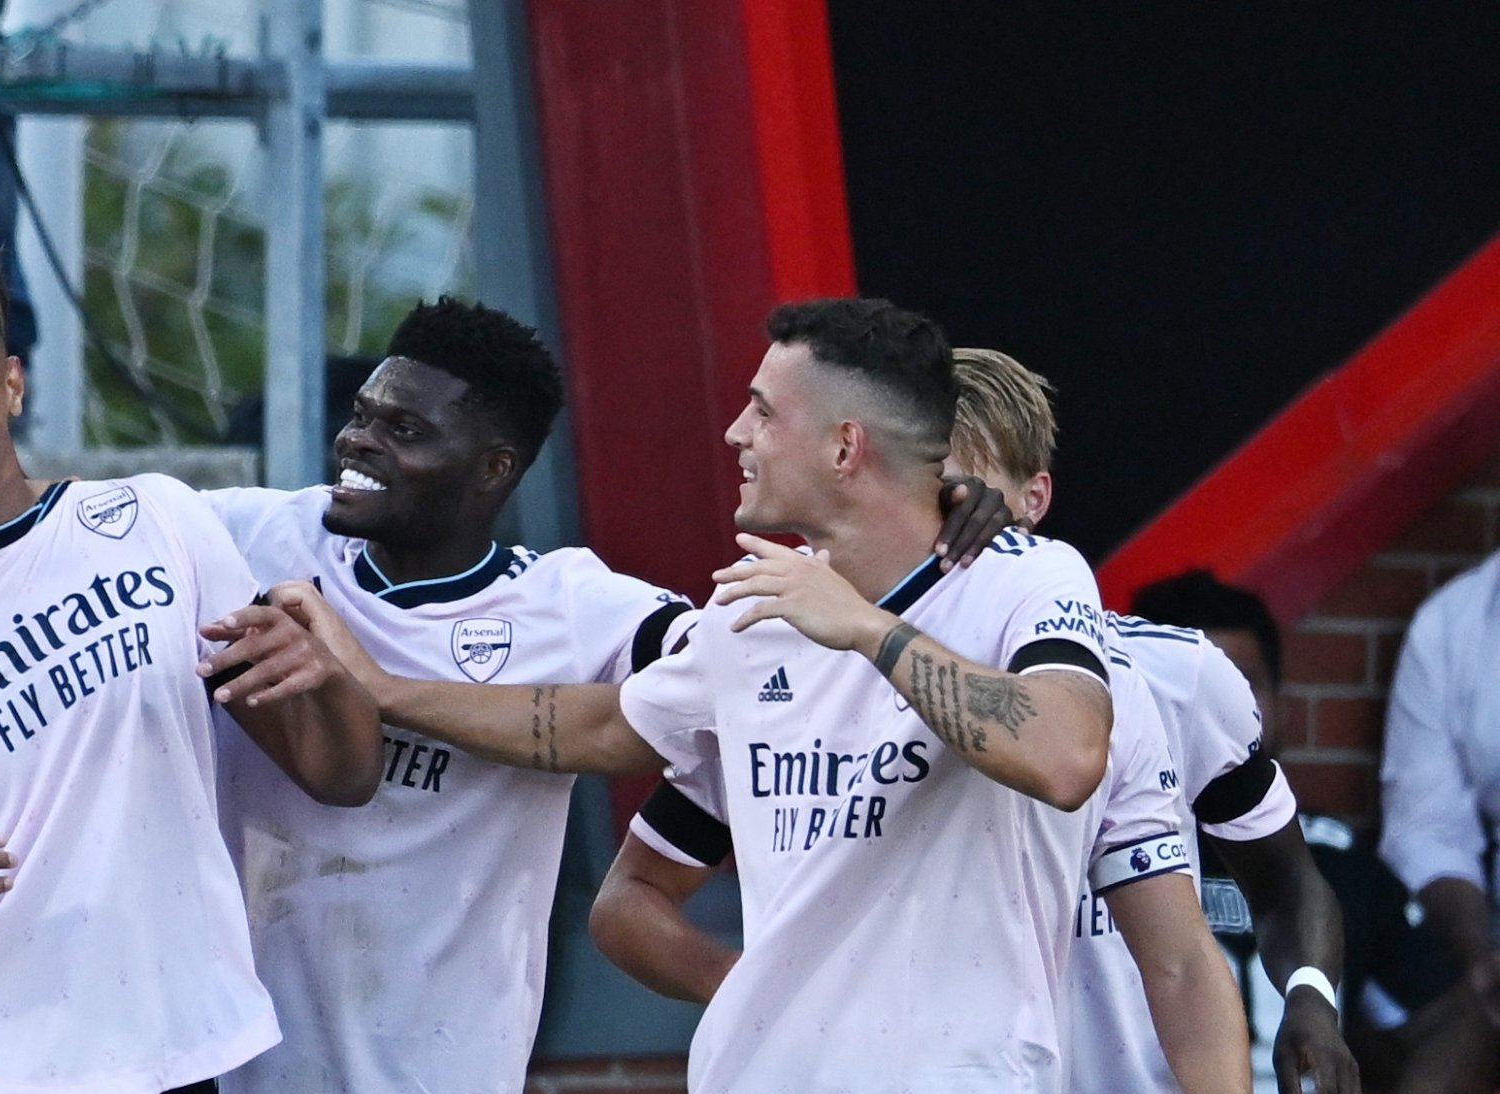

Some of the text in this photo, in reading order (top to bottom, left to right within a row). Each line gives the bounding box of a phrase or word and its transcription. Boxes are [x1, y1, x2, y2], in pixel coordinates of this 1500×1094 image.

[461, 627, 503, 637] Arsenal
[48, 622, 153, 710] BETTER
[758, 691, 793, 702] adidas
